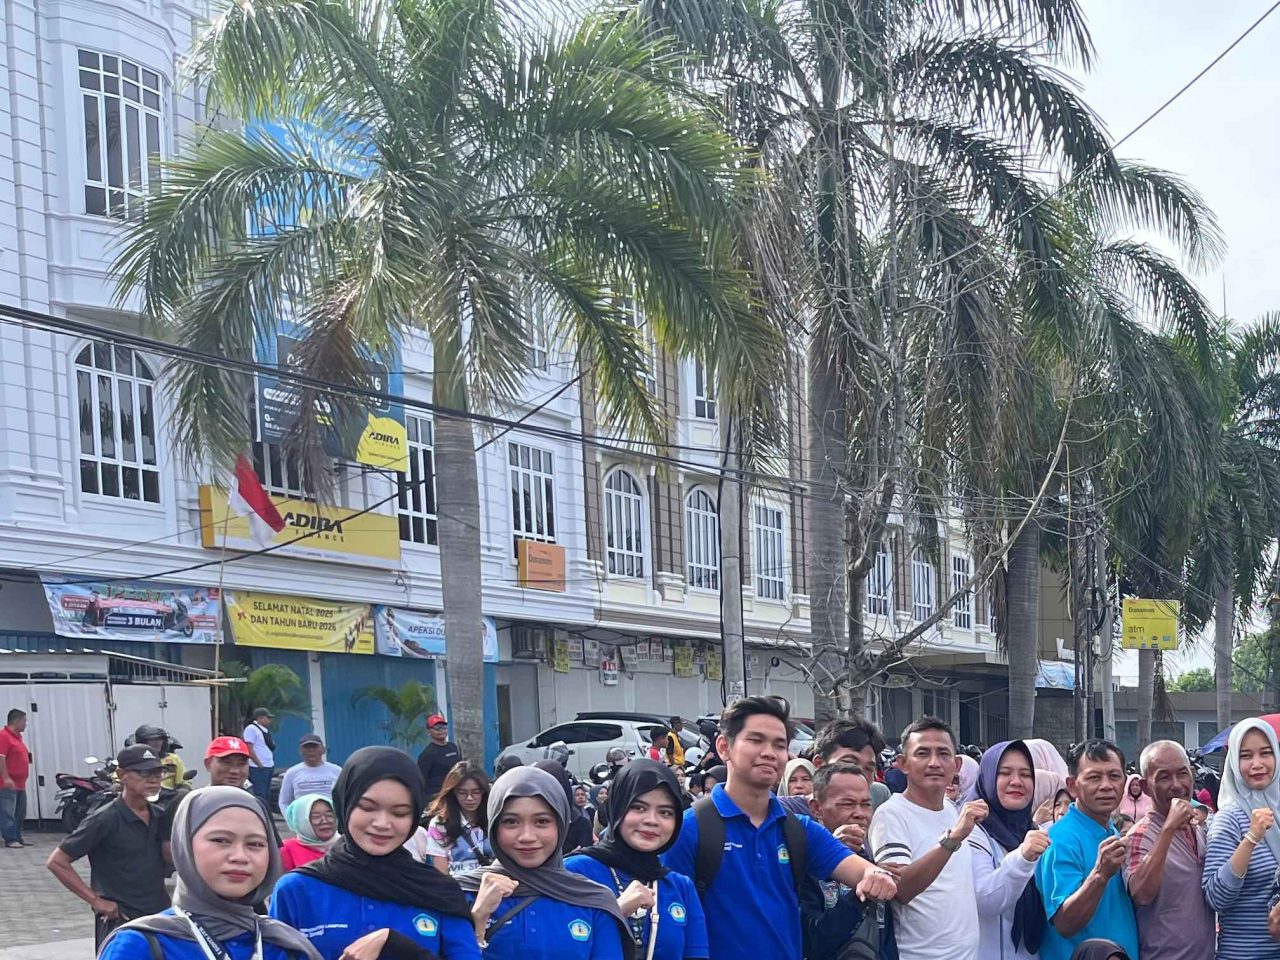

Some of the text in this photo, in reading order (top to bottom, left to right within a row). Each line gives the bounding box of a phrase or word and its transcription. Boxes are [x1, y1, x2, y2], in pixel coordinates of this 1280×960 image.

[369, 431, 400, 445] ADIRA
[284, 512, 343, 533] ADIRA
[253, 601, 334, 618] SELAMAT NATAL 2025
[128, 616, 134, 625] 3
[134, 617, 162, 627] BULAN
[250, 614, 337, 632] DAN TAHUN BARU 2026
[1128, 625, 1145, 633] atm
